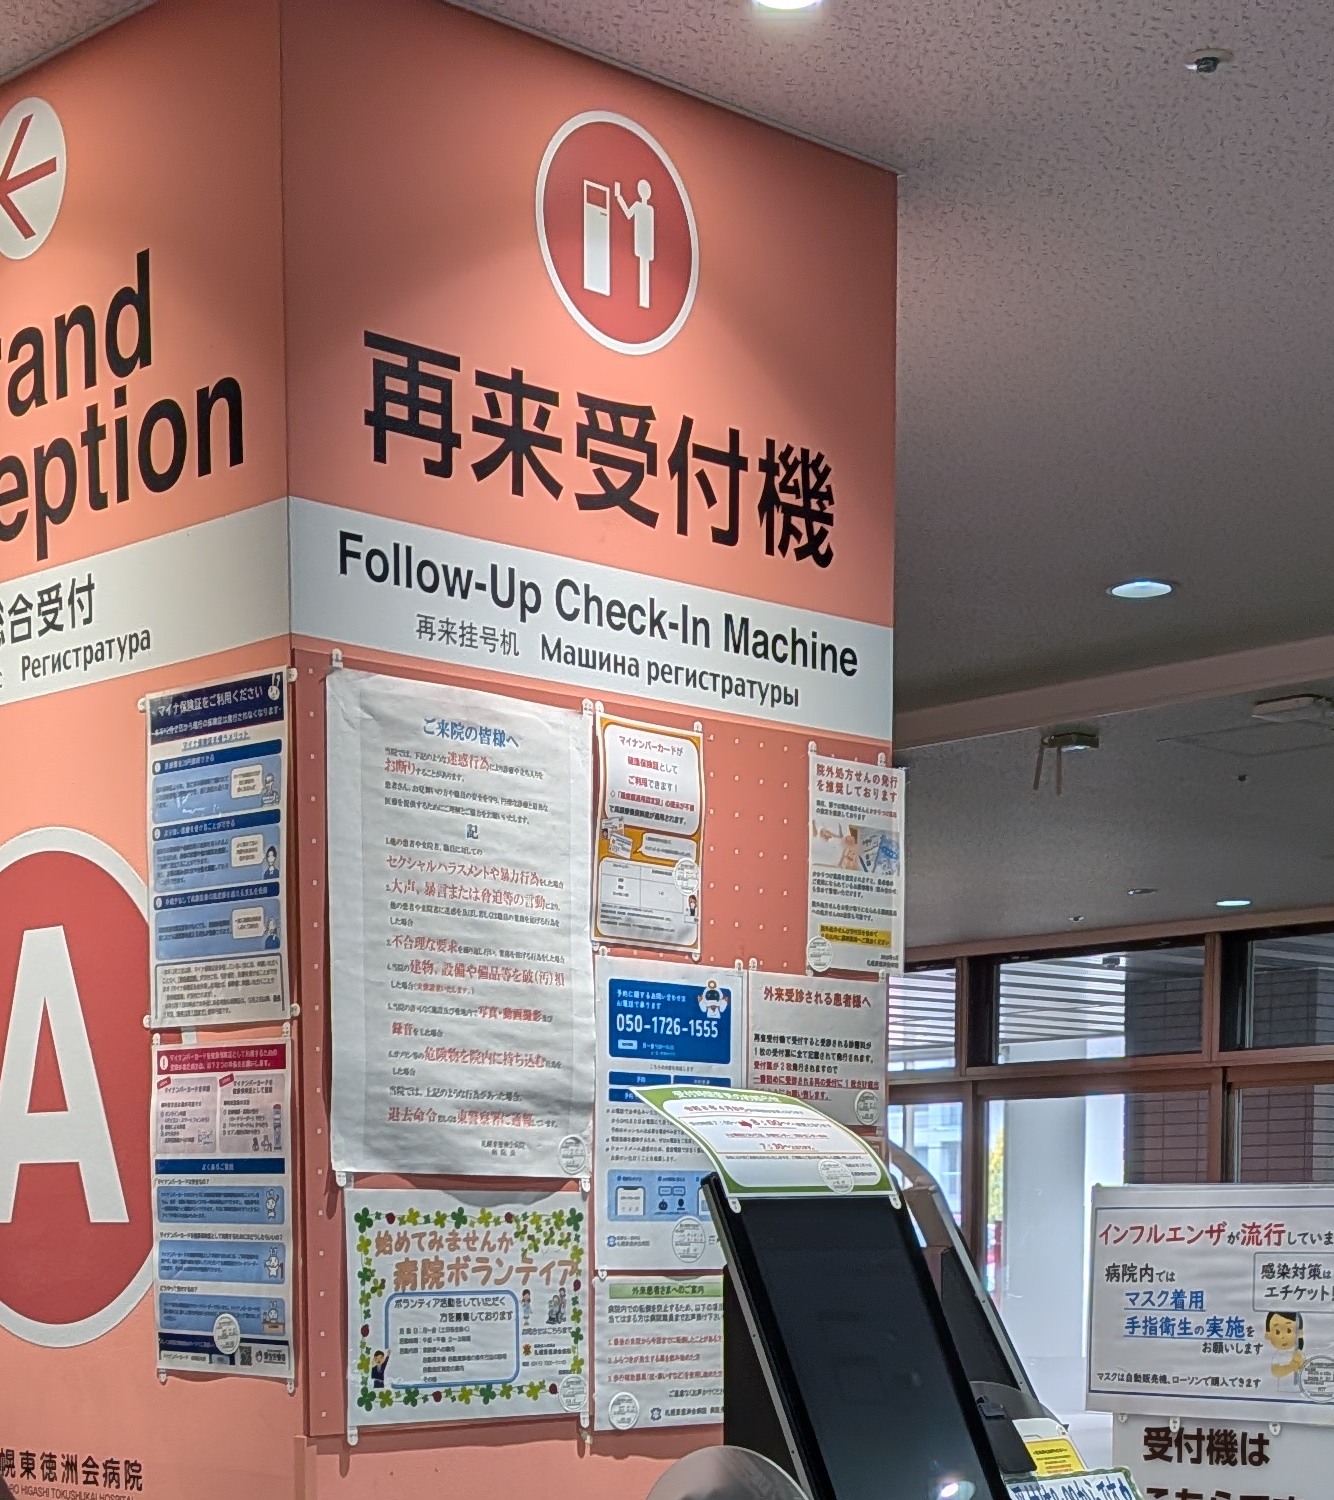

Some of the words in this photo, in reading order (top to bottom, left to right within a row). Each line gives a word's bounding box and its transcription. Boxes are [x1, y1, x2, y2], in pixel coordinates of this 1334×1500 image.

[363, 330, 837, 570] 再来受付機
[338, 530, 543, 617] Follow-Up
[554, 577, 714, 650] Check-In
[722, 613, 860, 678] Machine
[415, 613, 520, 658] 再来挂号机
[20, 625, 152, 680] Регистратура
[540, 633, 638, 685] Машина
[643, 660, 800, 710] регистратуры
[157, 685, 263, 718] マイナ保険証をご利用ください
[423, 718, 519, 748] ご来院の皆様へ
[619, 735, 684, 756] マイナンバーカードが
[816, 763, 898, 788] 院外処方せんの発行
[763, 986, 872, 1009] 外来受診される患者様へ
[616, 1013, 718, 1038] 050-1726-1555
[375, 1230, 514, 1257] 始めてみませんか
[393, 1255, 578, 1293] 病院ボランティア
[1105, 1263, 1176, 1284] 病院内では
[1261, 1263, 1332, 1280] 感染対策は
[394, 1296, 506, 1309] ボランティア活動をしていただく
[1125, 1289, 1205, 1311] マスク着用
[439, 1311, 513, 1323] 方を募集しております
[1125, 1315, 1255, 1339] 手指衛生の実施を
[1202, 1342, 1264, 1355] お願いします
[1096, 1372, 1262, 1389] マスクは自動販売機、ローソンで購入できます
[1142, 1426, 1271, 1467] 受付機は
[0, 1448, 143, 1491] 幌東徳洲会病院
[21, 1486, 49, 1498] HIGASHI
